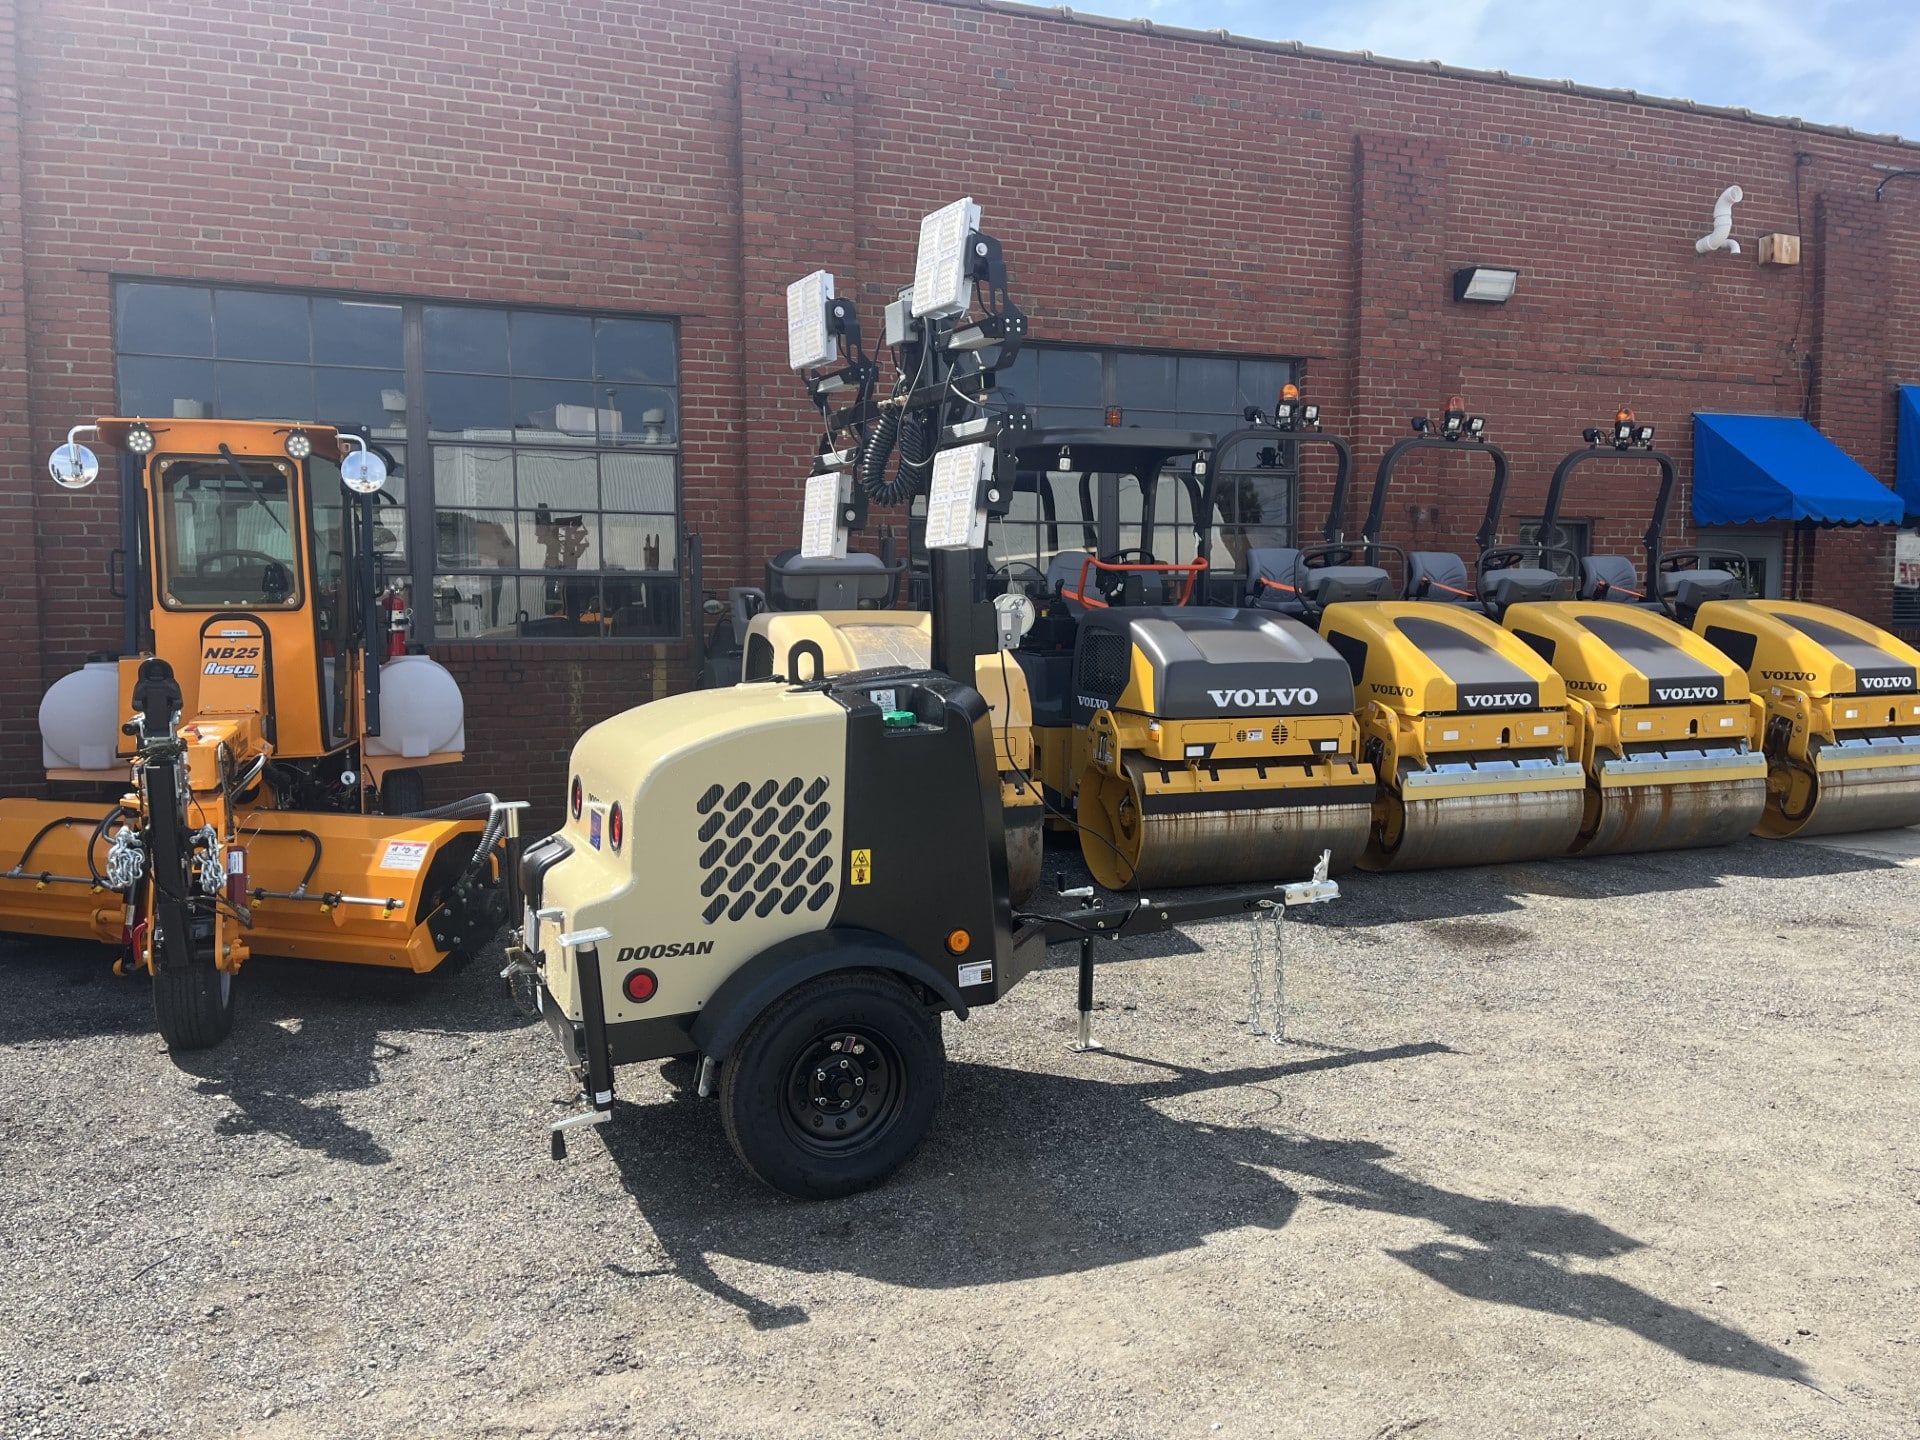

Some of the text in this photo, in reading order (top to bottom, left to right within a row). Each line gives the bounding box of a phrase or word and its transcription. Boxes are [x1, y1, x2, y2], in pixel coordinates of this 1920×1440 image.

[204, 647, 260, 659] NB25
[1760, 670, 1817, 682] VOLVO
[1861, 676, 1912, 689] VOLVO
[1207, 687, 1319, 708] VOLVO
[1370, 683, 1414, 698] VOLVO
[1655, 686, 1719, 701] VOLVO
[1077, 695, 1109, 710] VOLVO
[1464, 693, 1532, 708] VOLVO
[616, 940, 715, 963] DOOSAN
